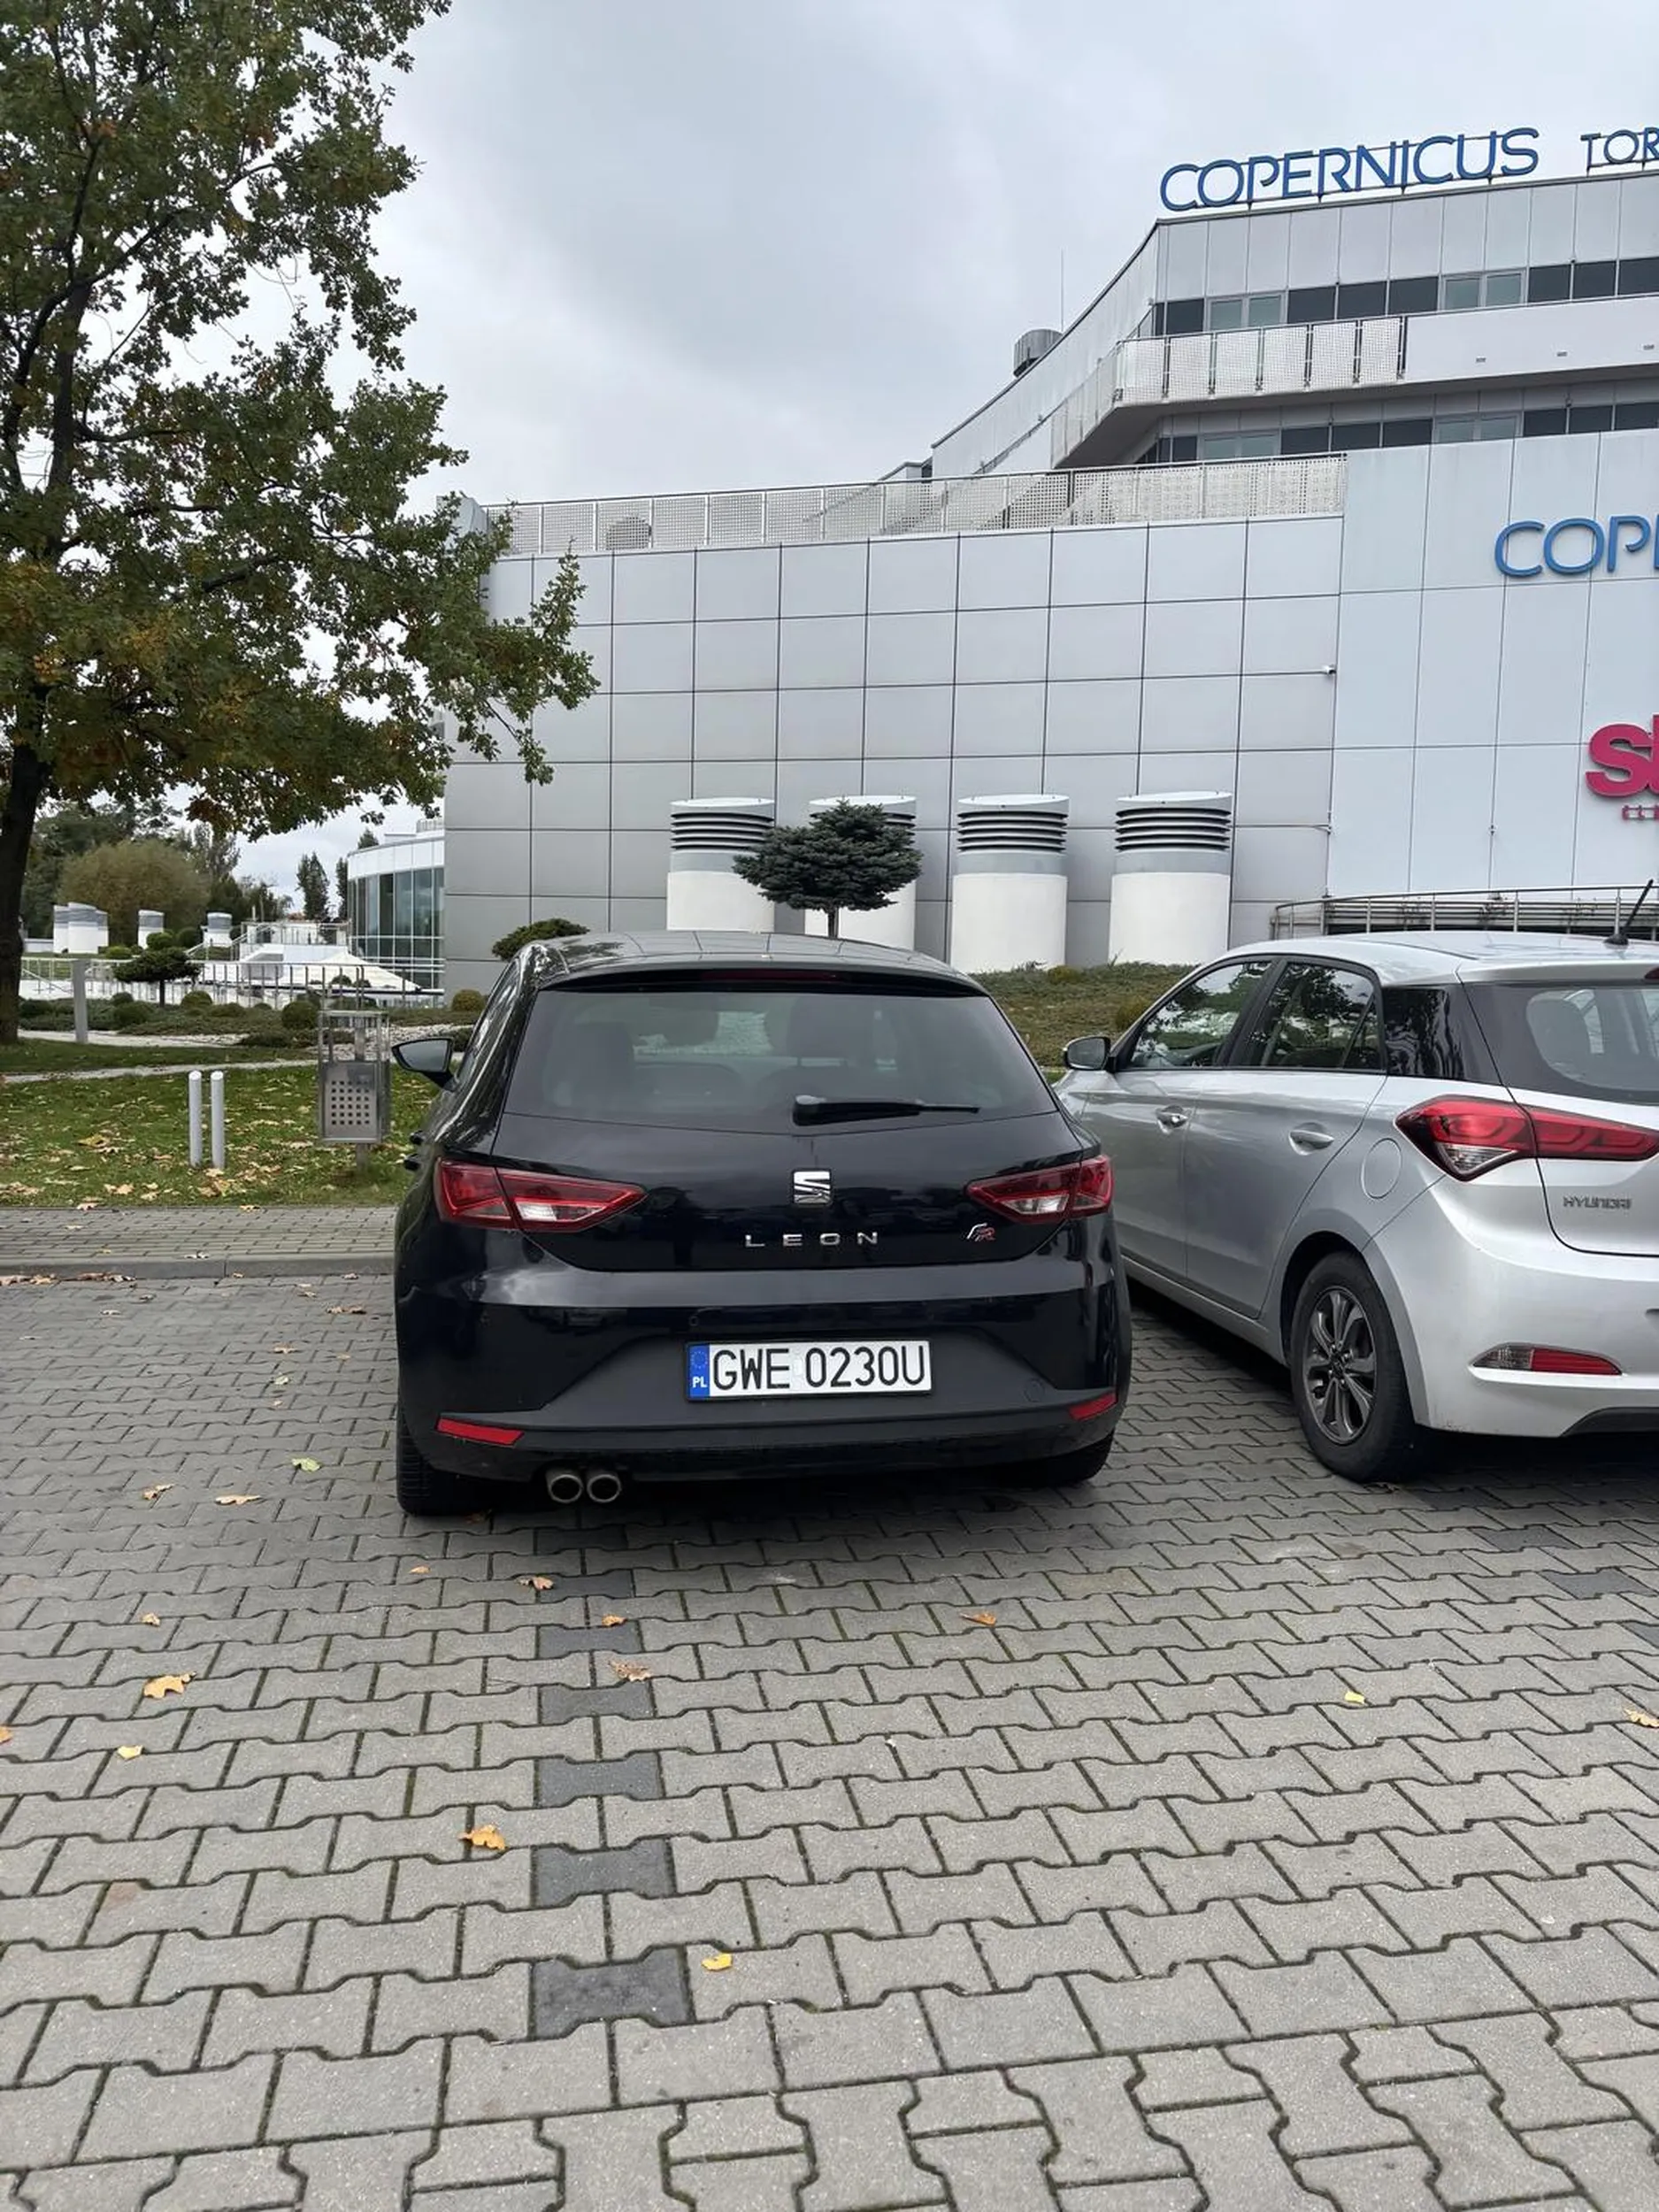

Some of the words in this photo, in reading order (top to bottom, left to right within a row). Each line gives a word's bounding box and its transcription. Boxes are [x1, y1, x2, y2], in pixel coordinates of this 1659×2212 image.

[1160, 127, 1540, 211] COPERNICUS
[1494, 514, 1659, 578] COP
[745, 1231, 879, 1248] LEON
[692, 1376, 708, 1388] PL
[713, 1348, 790, 1390] GWE
[805, 1345, 926, 1388] 0230U
